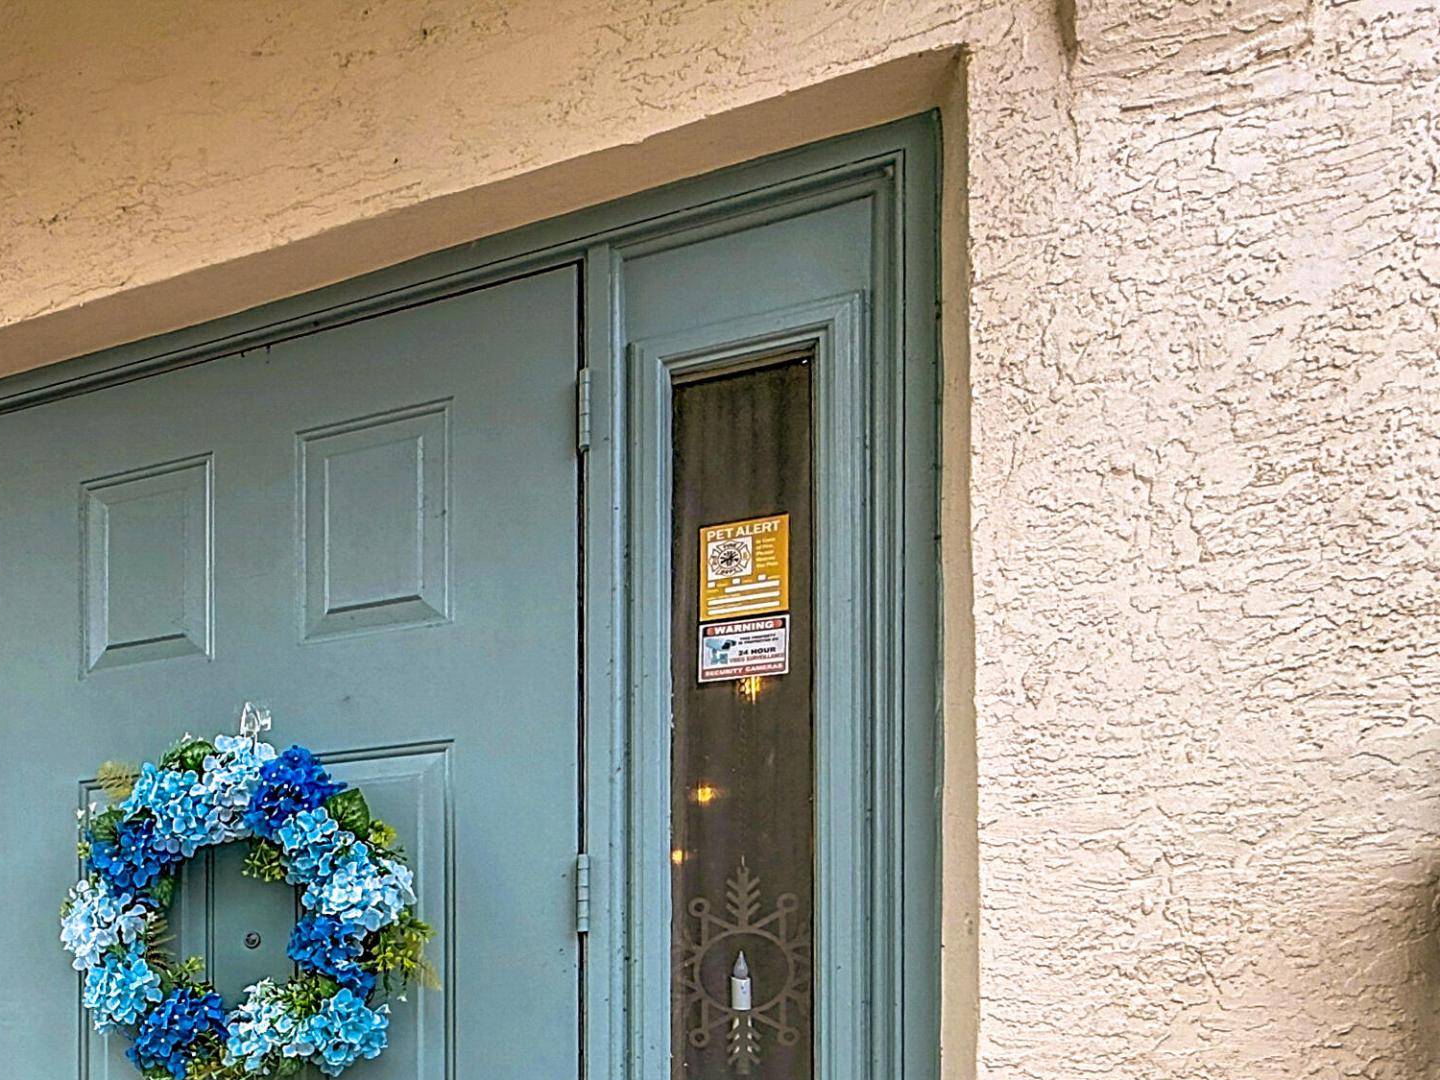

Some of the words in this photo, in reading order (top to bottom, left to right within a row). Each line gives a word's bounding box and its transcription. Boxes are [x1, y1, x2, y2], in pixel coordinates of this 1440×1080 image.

[707, 528, 734, 541] PET
[736, 520, 780, 538] ALERT
[714, 620, 775, 635] WARNING
[751, 646, 776, 655] HOUR
[705, 667, 743, 677] SECURITY
[745, 663, 783, 673] CAMERAS
